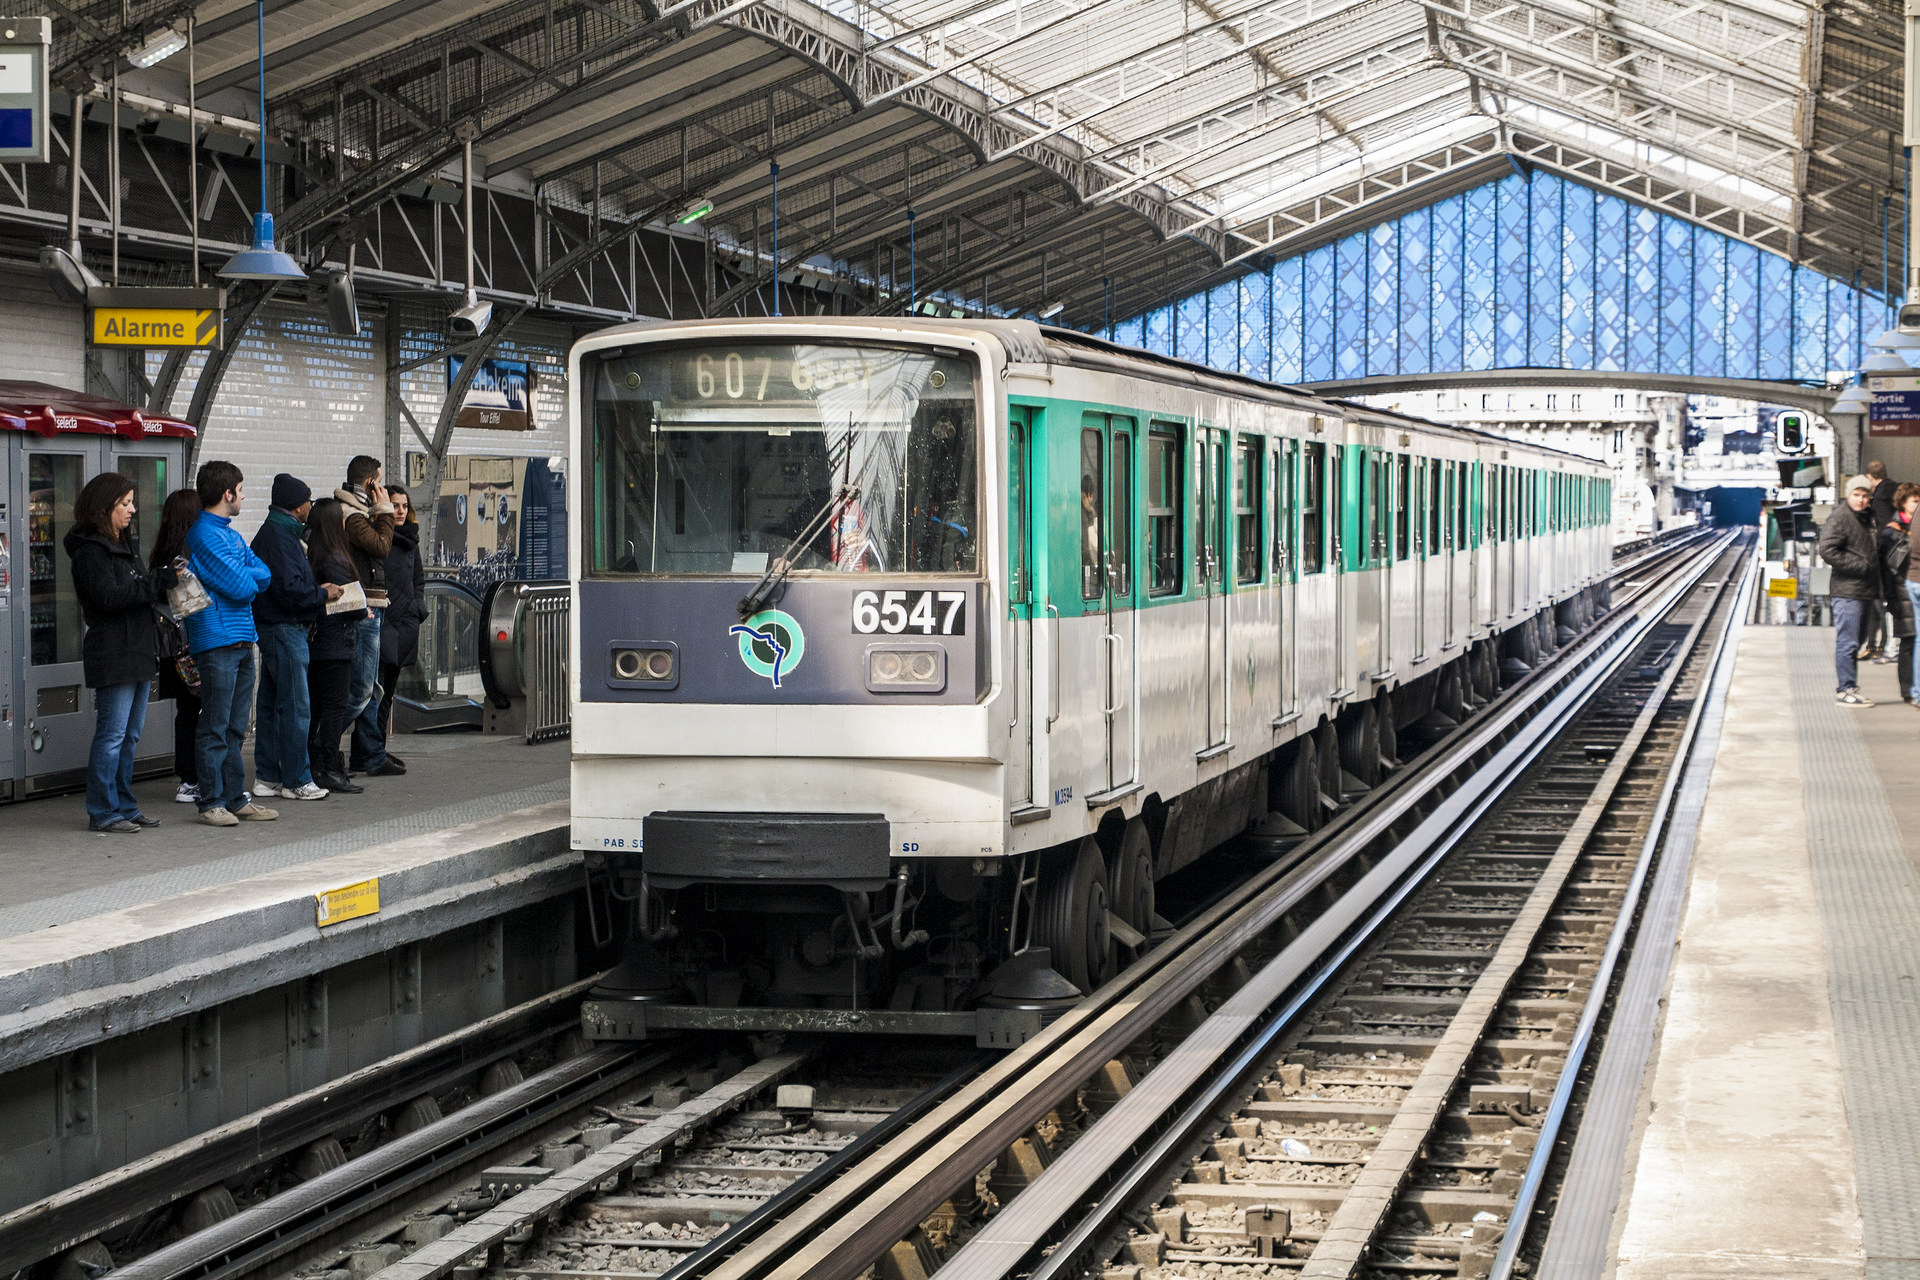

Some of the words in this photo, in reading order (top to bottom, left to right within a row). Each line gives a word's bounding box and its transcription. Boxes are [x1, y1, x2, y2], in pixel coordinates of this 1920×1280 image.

[104, 317, 184, 338] Alarme
[471, 367, 522, 401] -Hakeim
[696, 353, 772, 401] 607
[57, 417, 77, 429] selecta
[143, 421, 163, 432] selecta
[480, 411, 490, 424] Tour
[490, 412, 501, 424] Eiffel
[853, 590, 966, 635] 6547
[1054, 785, 1073, 806] M.3594
[902, 842, 920, 852] SD
